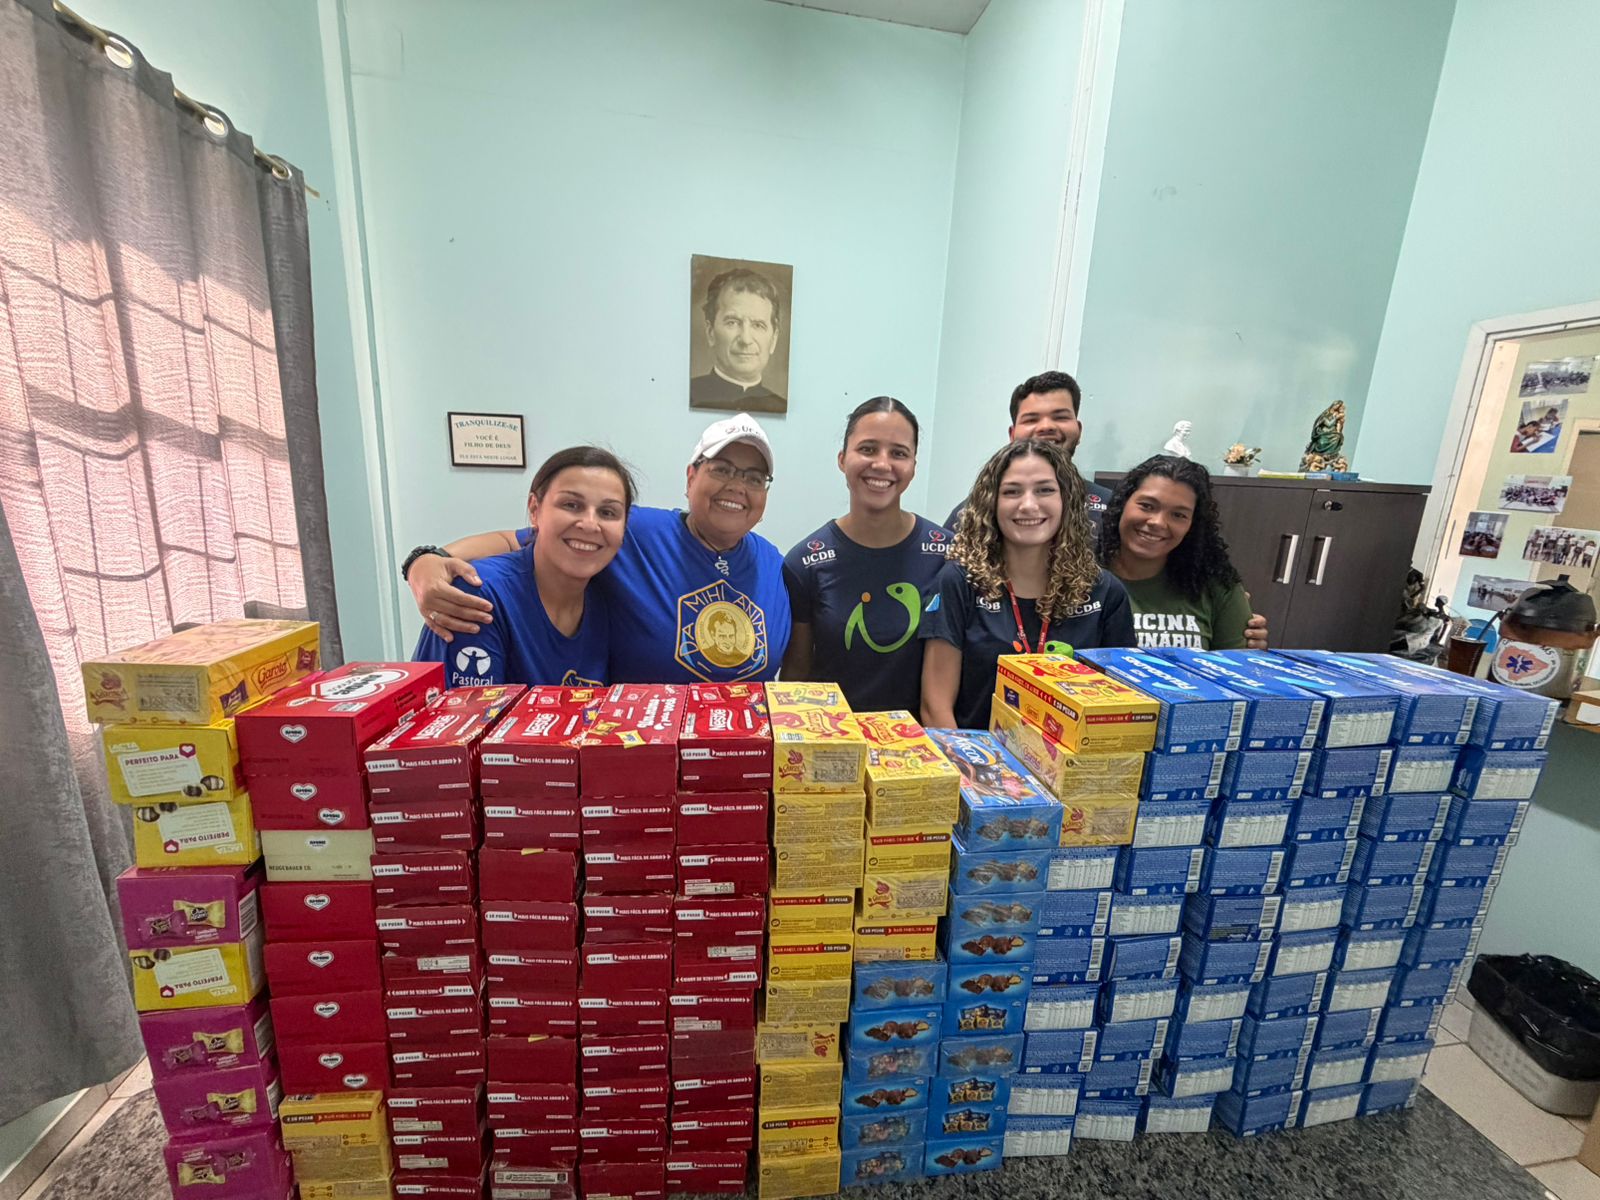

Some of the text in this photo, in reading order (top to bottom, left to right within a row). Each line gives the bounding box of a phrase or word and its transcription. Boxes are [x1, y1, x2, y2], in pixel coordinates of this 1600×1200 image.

[454, 419, 518, 432] TRANQUILIZE-SE
[802, 550, 836, 566] UCDB
[680, 584, 765, 664] DA MIHI ANIMAS
[1136, 631, 1202, 649] INÁRIA
[257, 661, 287, 684] Garoto
[452, 672, 493, 686] Pastoral
[125, 756, 159, 766] PERFEITO
[198, 832, 230, 841] PERFEITO
[193, 975, 223, 986] PERFEITO
